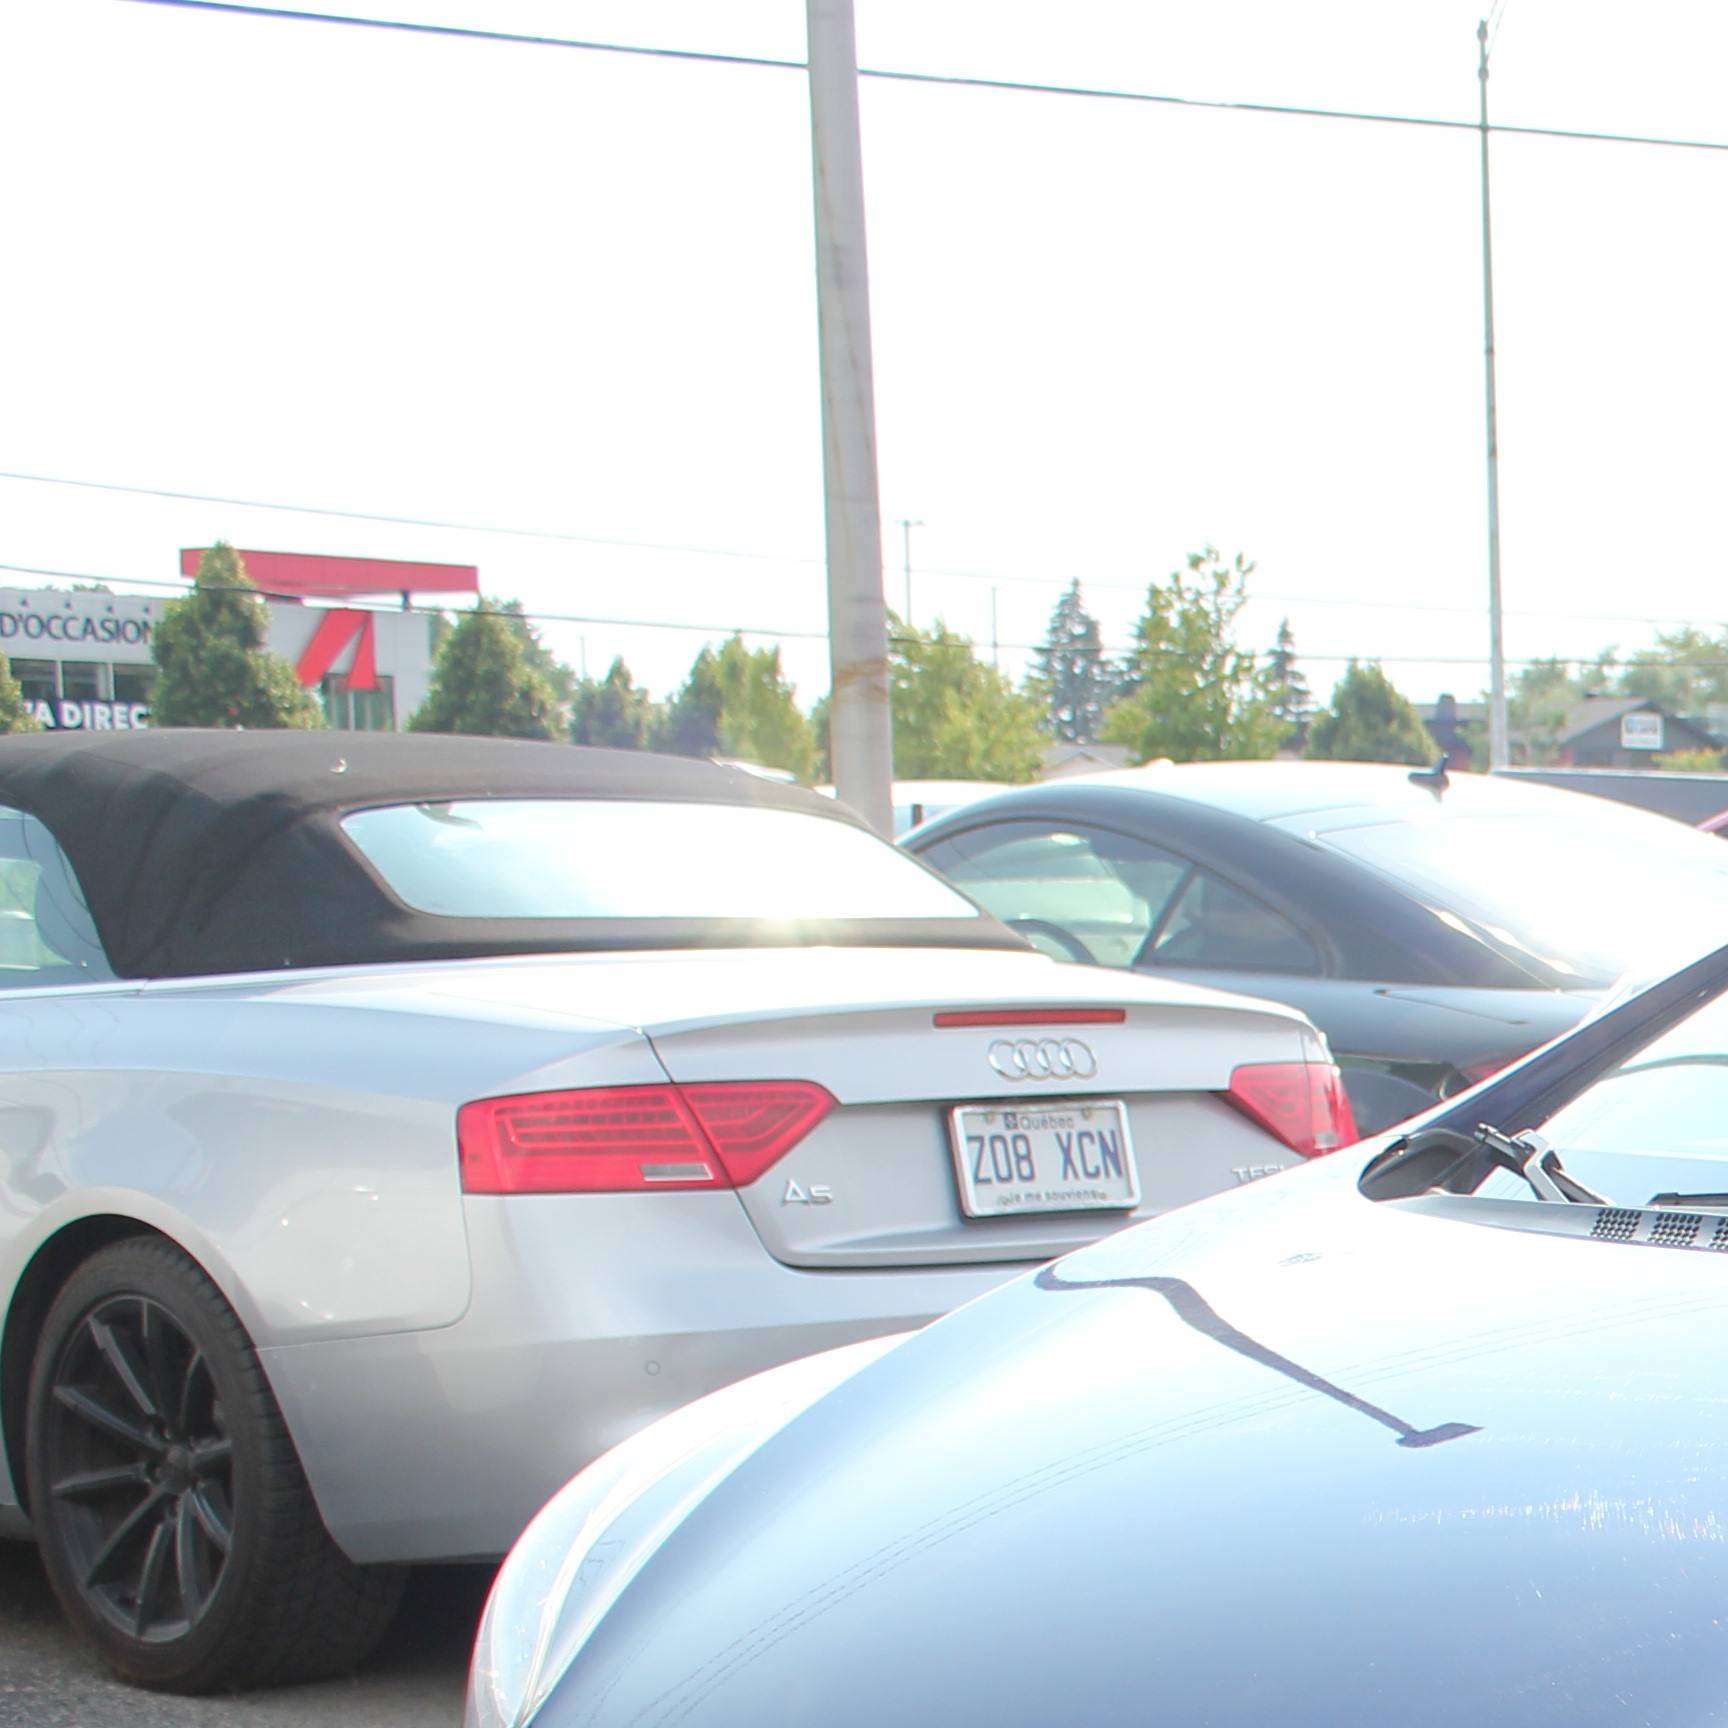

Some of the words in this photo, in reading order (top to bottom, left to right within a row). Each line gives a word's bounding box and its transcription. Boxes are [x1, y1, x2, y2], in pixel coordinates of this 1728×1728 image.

[59, 701, 153, 730] DIREC
[1020, 1115, 1075, 1130] Québec
[1055, 1129, 1123, 1181] XCN
[784, 1179, 833, 1204] A5
